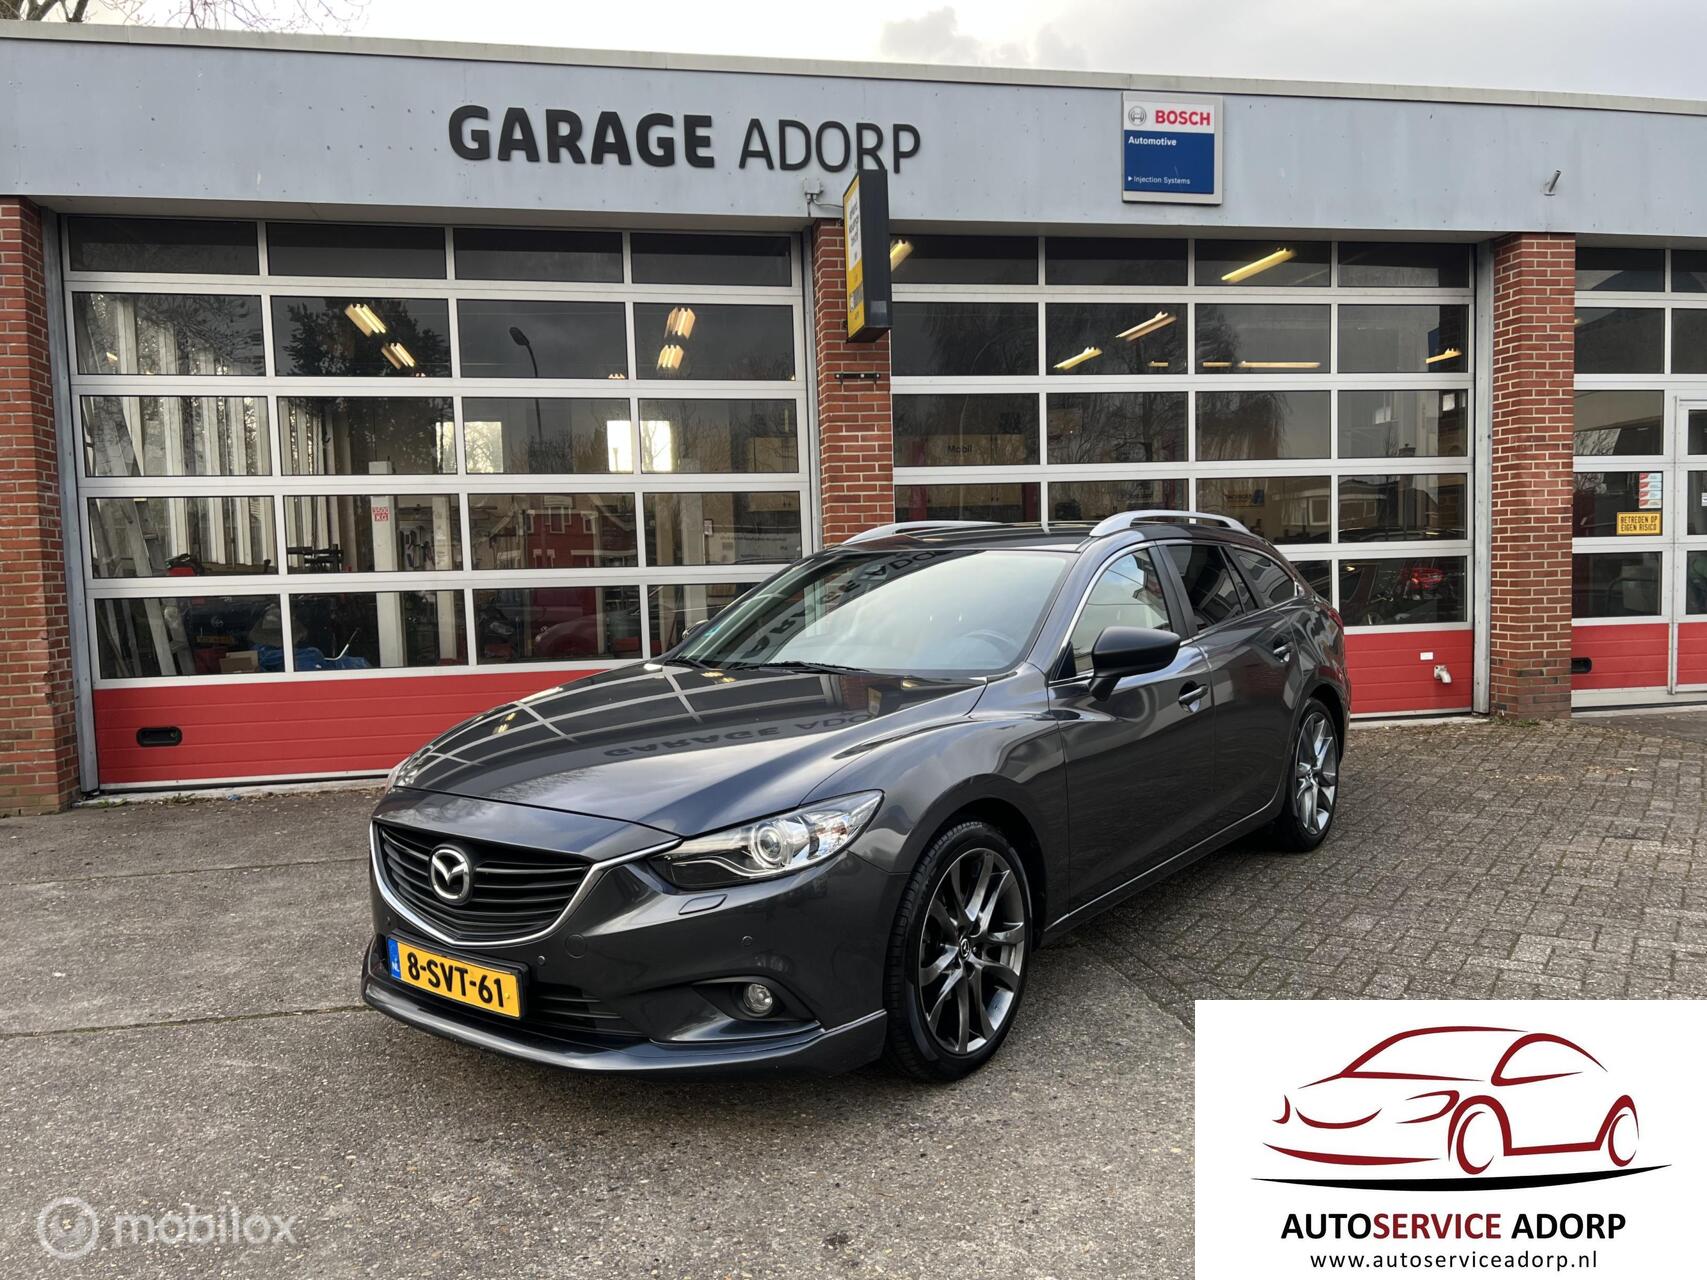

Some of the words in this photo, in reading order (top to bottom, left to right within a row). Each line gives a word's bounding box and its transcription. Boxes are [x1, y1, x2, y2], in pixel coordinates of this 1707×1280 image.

[1155, 110, 1211, 126] BOSCH
[448, 104, 715, 169] GARAGE
[738, 117, 921, 174] ADORP
[1127, 135, 1177, 146] Automotive
[1133, 175, 1162, 184] Injection
[1163, 176, 1191, 185] Systems
[1621, 516, 1649, 524] BETREDEN
[1651, 515, 1658, 523] OP
[1640, 523, 1657, 531] RISICO
[391, 961, 400, 972] NL
[406, 951, 505, 1008] 8-SVT-61
